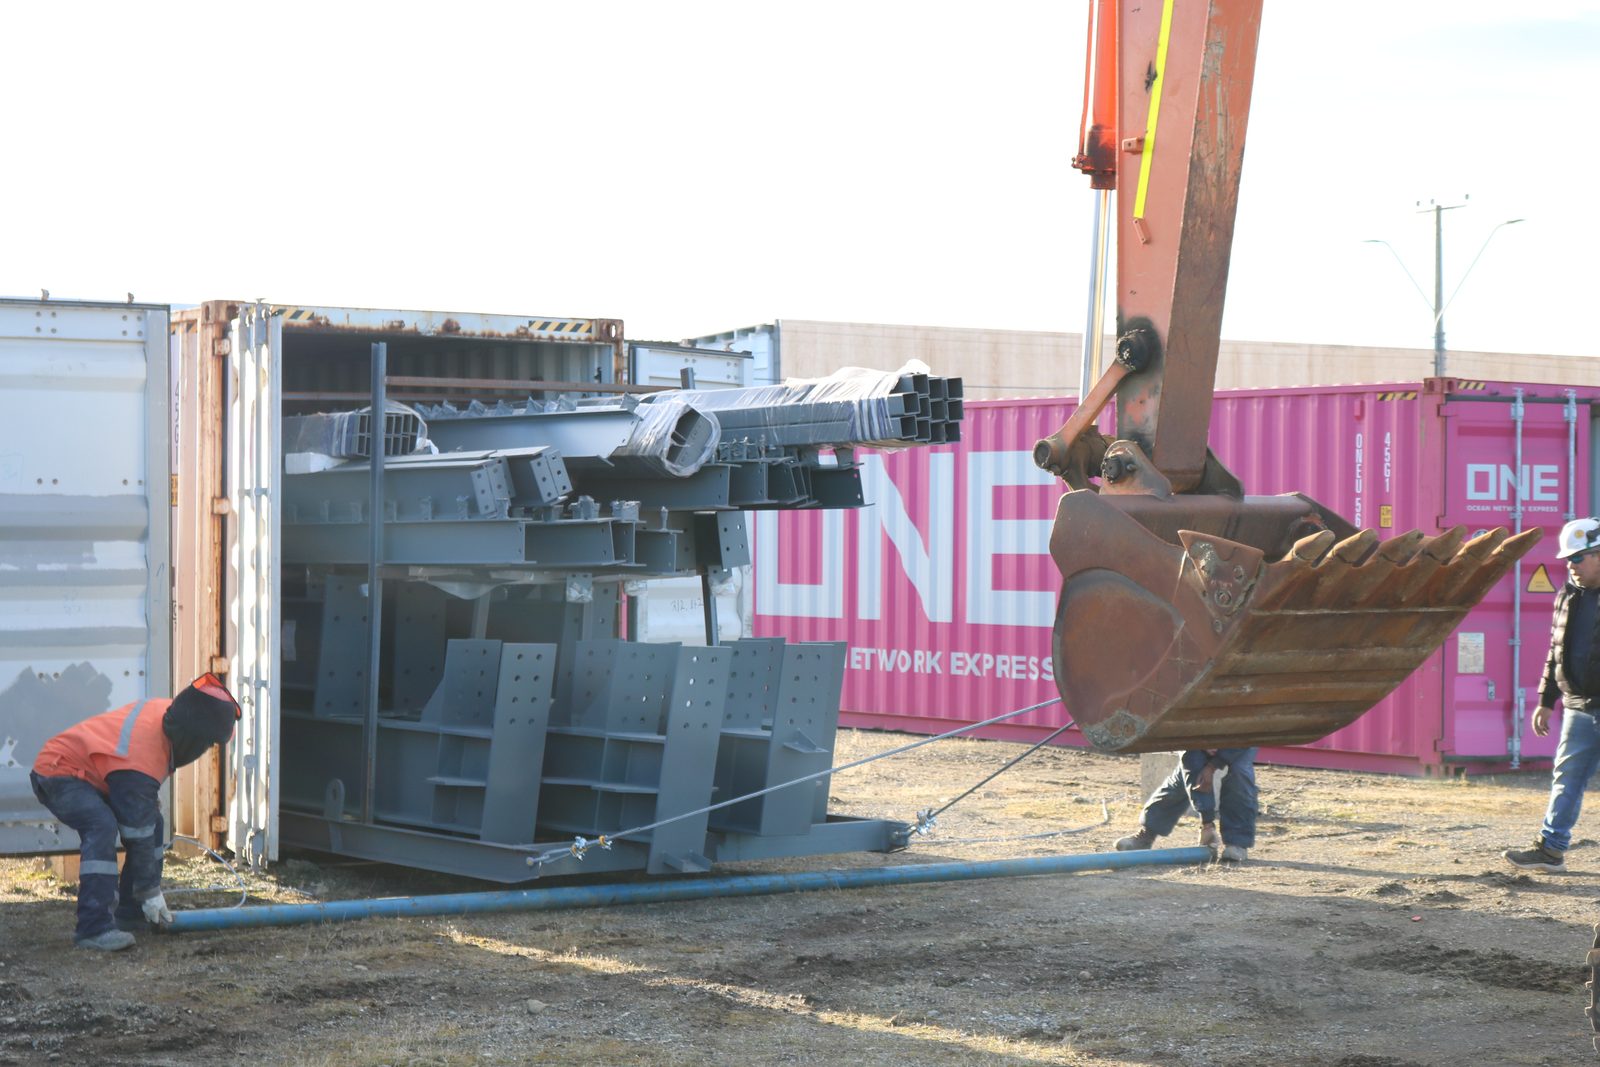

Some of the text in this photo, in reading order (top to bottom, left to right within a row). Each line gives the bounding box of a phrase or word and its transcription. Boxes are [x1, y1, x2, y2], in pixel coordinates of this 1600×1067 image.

[1355, 432, 1363, 494] ONEU
[1383, 431, 1391, 493] 45G1
[1466, 463, 1559, 501] ONE
[1466, 504, 1491, 512] OCEAN
[1528, 505, 1559, 513] EXPRESS
[755, 451, 1057, 627] ONE
[844, 646, 1055, 681] ETWORK EXPRESS
